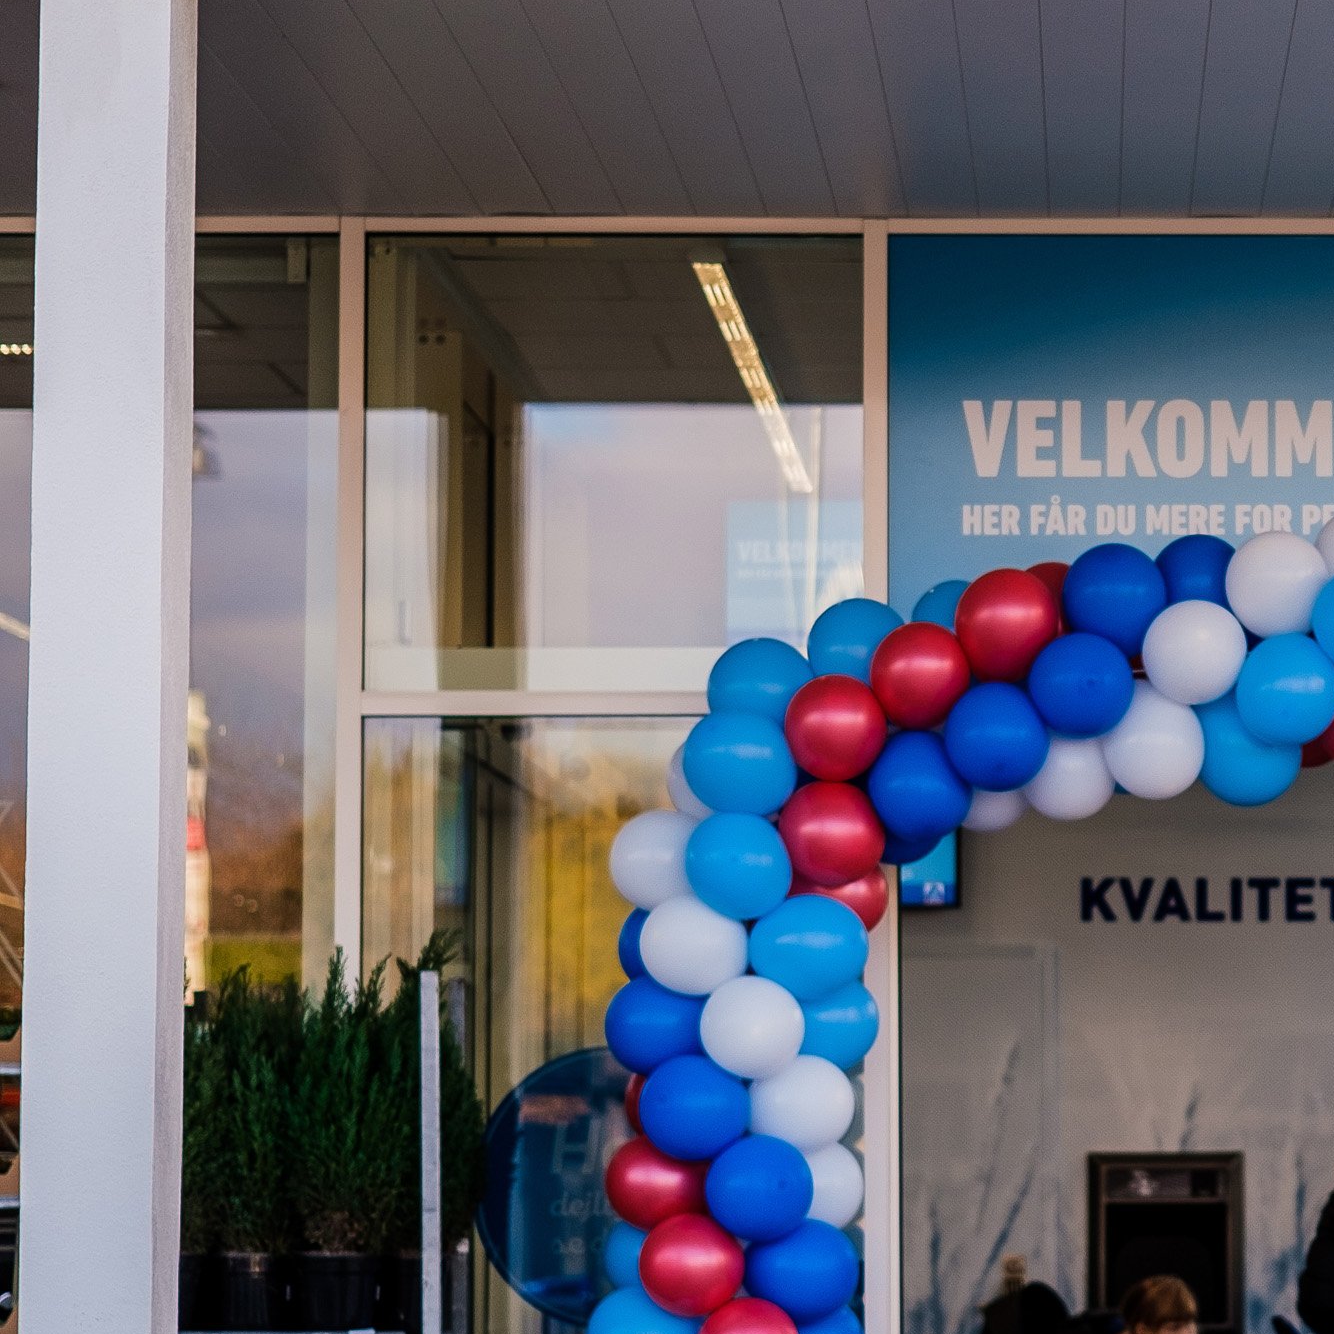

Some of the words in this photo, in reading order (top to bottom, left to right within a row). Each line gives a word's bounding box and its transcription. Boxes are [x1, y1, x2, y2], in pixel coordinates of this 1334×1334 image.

[962, 504, 1020, 535] HER
[1030, 495, 1086, 535] FÅR
[1097, 504, 1136, 535] DU
[1146, 504, 1225, 535] MERE
[1235, 504, 1292, 534] FOR
